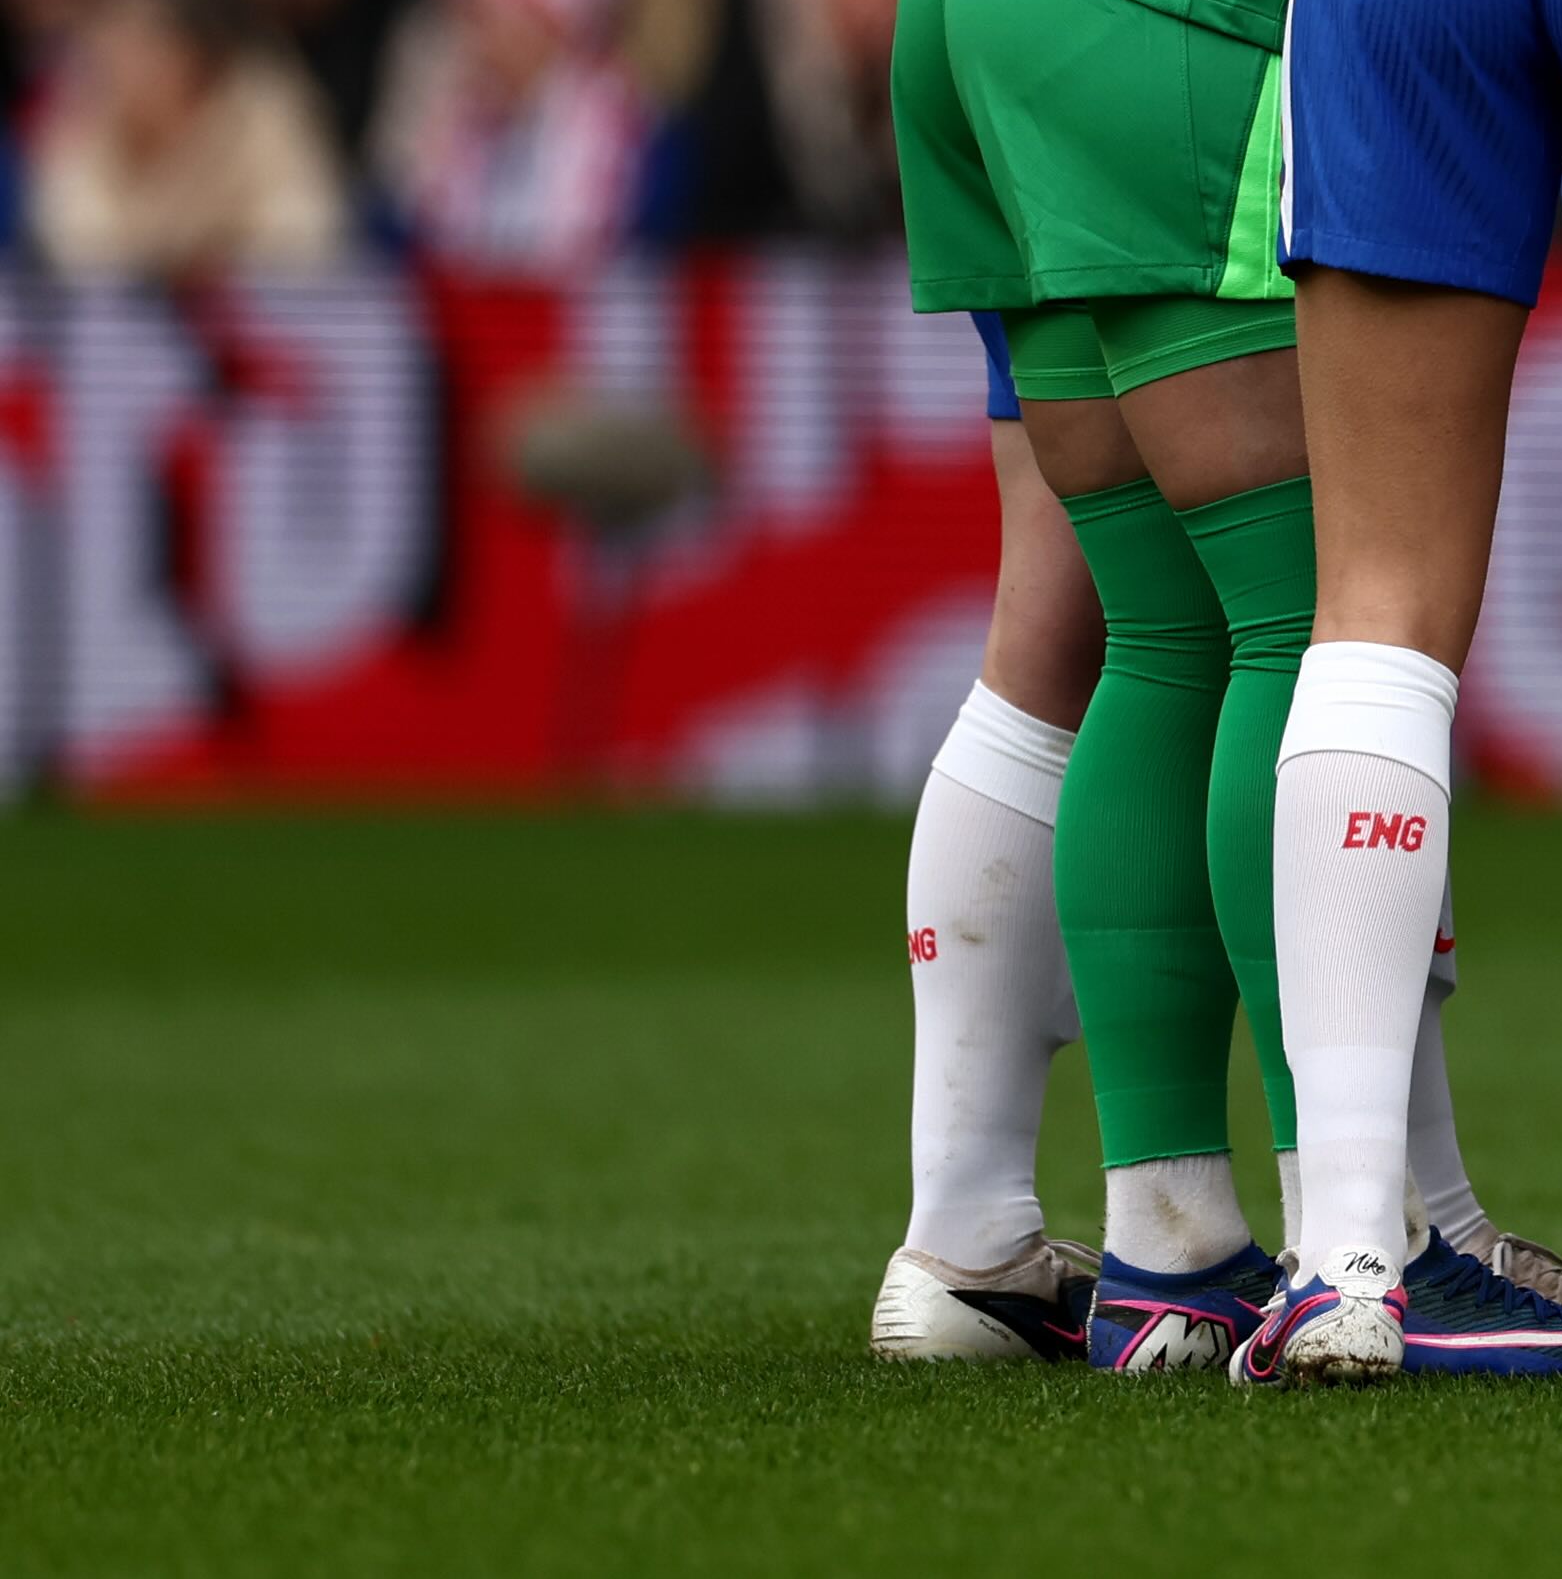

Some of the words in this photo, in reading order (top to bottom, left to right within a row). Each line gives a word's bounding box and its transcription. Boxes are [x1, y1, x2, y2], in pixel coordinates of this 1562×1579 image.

[1343, 811, 1428, 853] ENG
[906, 927, 938, 965] NG
[1342, 1251, 1387, 1277] Nike
